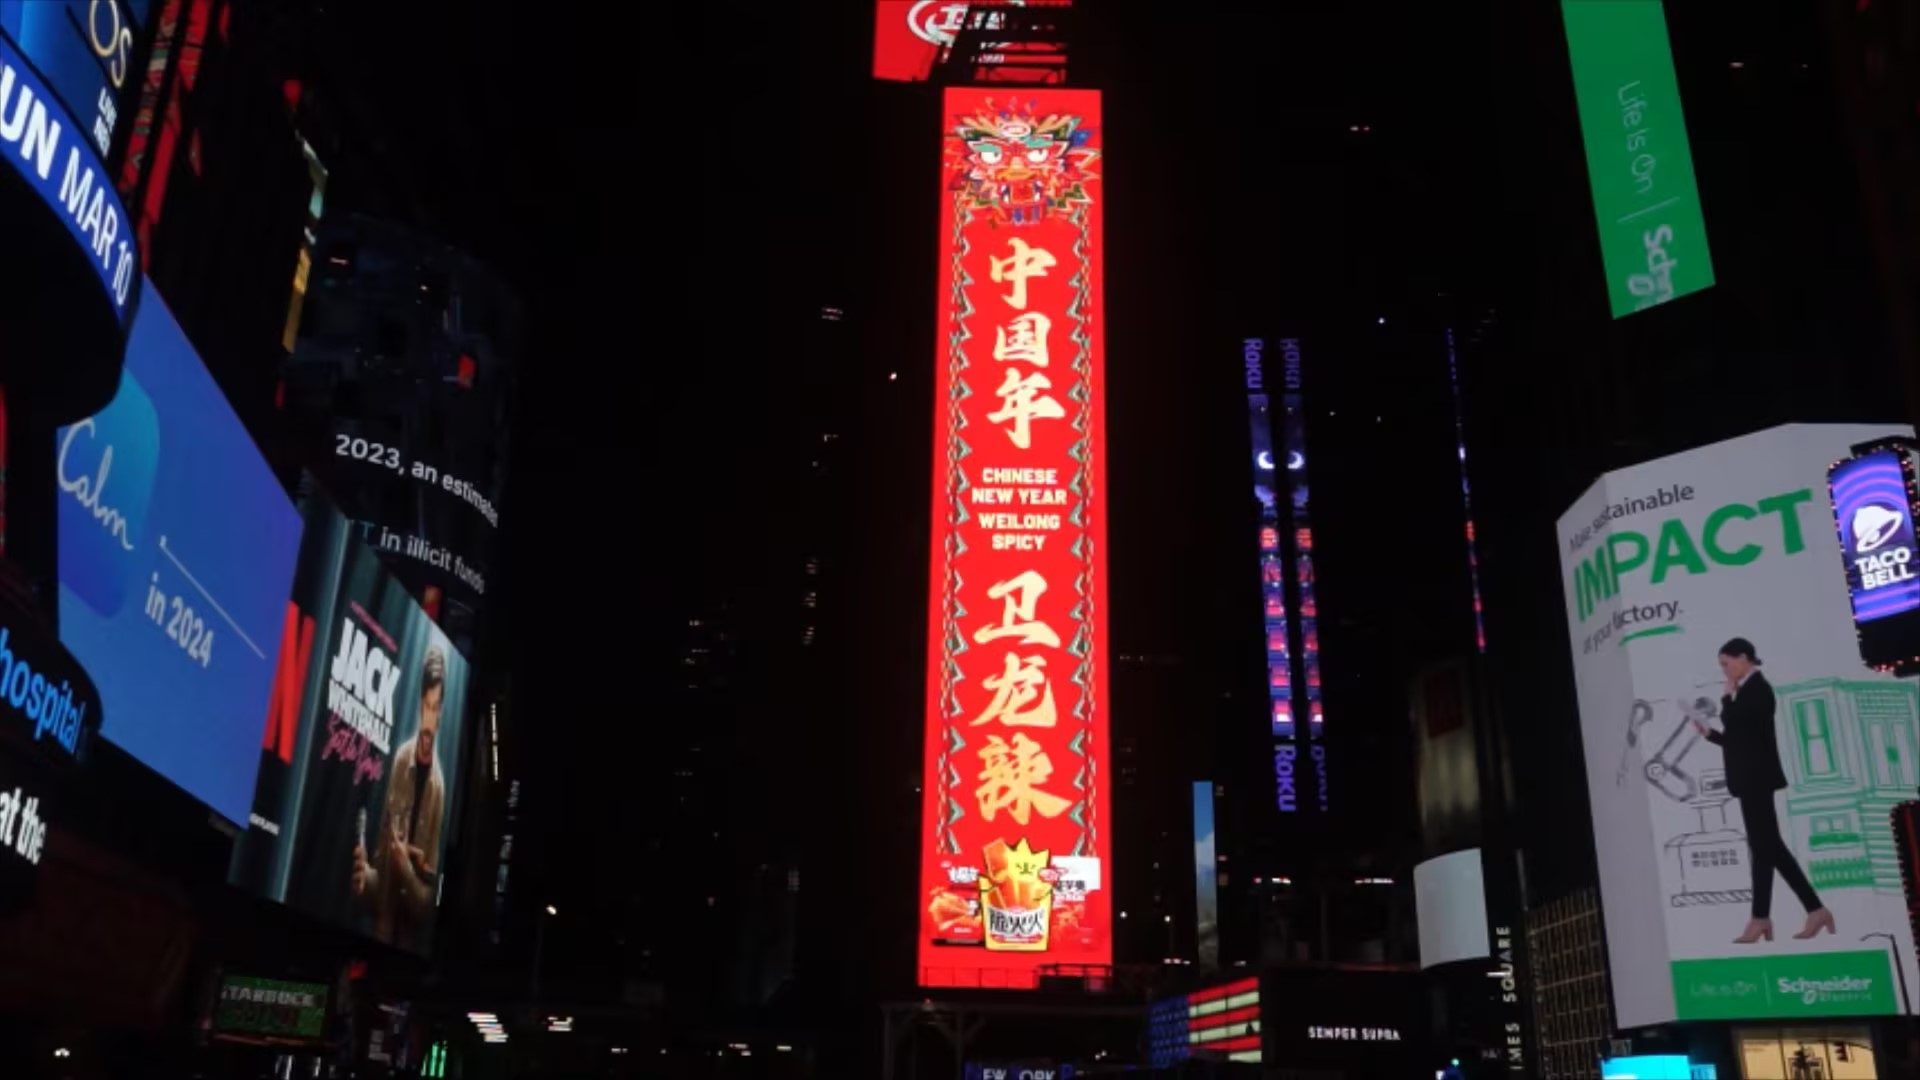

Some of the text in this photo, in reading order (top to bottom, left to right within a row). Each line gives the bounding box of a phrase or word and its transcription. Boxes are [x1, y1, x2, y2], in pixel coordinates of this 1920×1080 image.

[1617, 80, 1646, 128] Life
[59, 146, 118, 270] MAR
[112, 240, 133, 306] 10
[986, 237, 1066, 450] 中国年
[57, 416, 134, 551] Calm
[336, 434, 405, 475] 2023,
[412, 461, 438, 484] an
[982, 467, 1058, 485] CHINESE
[971, 487, 1067, 505] NEW YEAR
[978, 513, 1061, 531] WEILONG
[992, 534, 1045, 552] SPICY
[380, 526, 401, 551] in
[407, 535, 451, 572] illicit
[1574, 488, 1813, 624] IMPACT
[1855, 546, 1911, 577] TACO
[1861, 563, 1917, 591] BELL
[144, 571, 214, 669] in 2024
[0, 628, 85, 755] hospital
[331, 617, 400, 727] JACK
[968, 569, 1073, 826] 卫龙辣
[16, 796, 47, 866] the
[1495, 926, 1518, 1003] SQUARE
[1776, 976, 1873, 995] Schneider
[1307, 1025, 1401, 1041] SEMPER SUPRA
